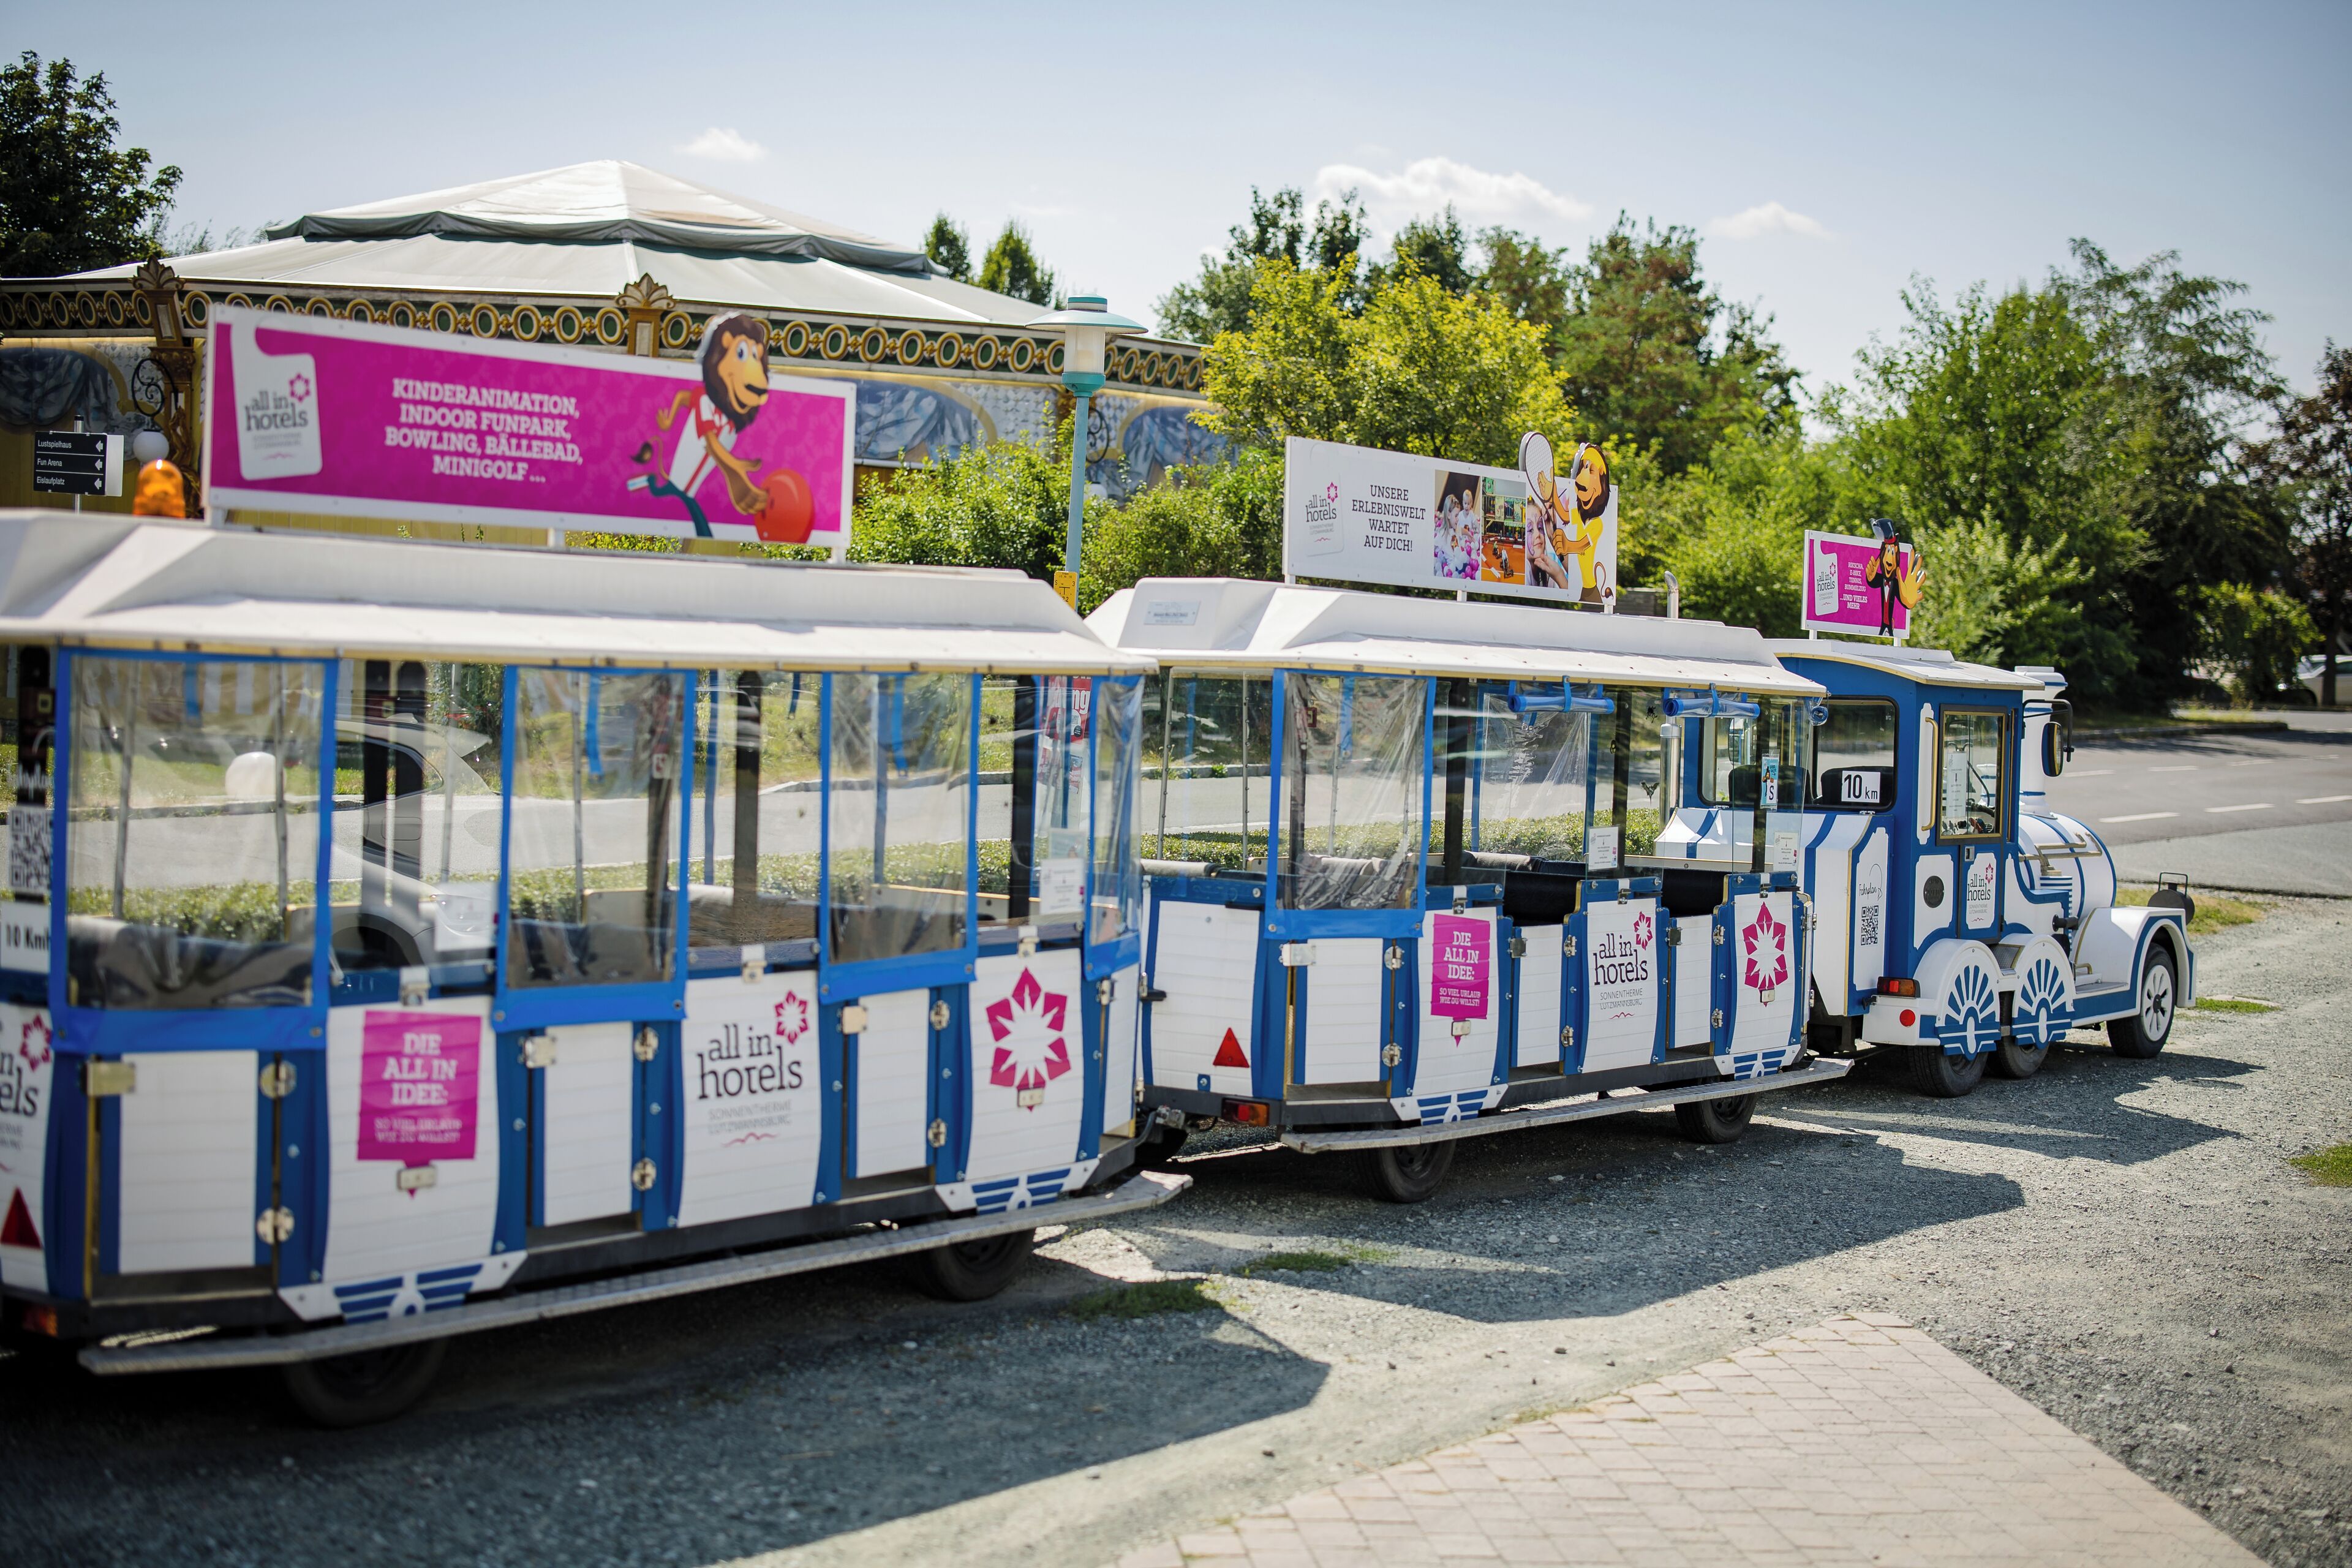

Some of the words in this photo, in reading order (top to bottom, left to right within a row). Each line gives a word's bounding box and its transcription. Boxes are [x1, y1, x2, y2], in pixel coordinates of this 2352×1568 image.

[251, 390, 270, 411] all
[273, 391, 289, 410] in
[392, 377, 580, 419] KINDERANIMATION,
[245, 402, 309, 431] hotels
[399, 402, 477, 429] INDOOR
[480, 411, 571, 441] FUNPARK,
[38, 439, 72, 449] Lustspielhaus
[384, 425, 482, 456] BOWLING,
[484, 432, 584, 466] BÄLLEBAD,
[432, 454, 529, 481] MINIGOLF
[37, 476, 65, 486] Eislaufplatz
[1370, 484, 1409, 501] UNSERE
[1308, 494, 1318, 509] all
[1319, 495, 1327, 508] in
[1352, 499, 1426, 520] ERLEBNISWELT
[1305, 502, 1337, 522] hotels
[1368, 518, 1409, 535] WARTET
[1363, 535, 1384, 549] AUF
[1385, 537, 1413, 552] DICH!
[1817, 577, 1835, 592] hotels
[1825, 572, 1830, 581] in
[1847, 601, 1860, 610] MEHR
[1853, 595, 1868, 603] VIELES
[1844, 774, 1863, 799] 10
[1865, 786, 1878, 800] km
[1978, 875, 1985, 888] in
[1859, 883, 1877, 900] Fahrplan
[1967, 883, 1991, 901] hotels
[6, 924, 21, 948] 10
[1452, 931, 1471, 946] DIE
[1599, 933, 1617, 960] all
[1618, 934, 1634, 957] in
[1443, 947, 1466, 963] ALL
[1466, 949, 1480, 964] IN
[1447, 964, 1475, 980] IDEE:
[1593, 949, 1648, 986] hotels
[1447, 988, 1460, 997] VIEL
[1460, 989, 1481, 998] URLAUB
[1600, 988, 1643, 1001] SONNENTHERME
[1600, 998, 1643, 1010] LUTZMANNSBURG
[403, 1032, 442, 1056] DIE
[708, 1023, 741, 1061] all
[747, 1025, 772, 1057] in
[382, 1057, 429, 1080] ALL
[431, 1058, 458, 1082] IN
[697, 1045, 802, 1099] hotels
[391, 1082, 448, 1106] IDEE:
